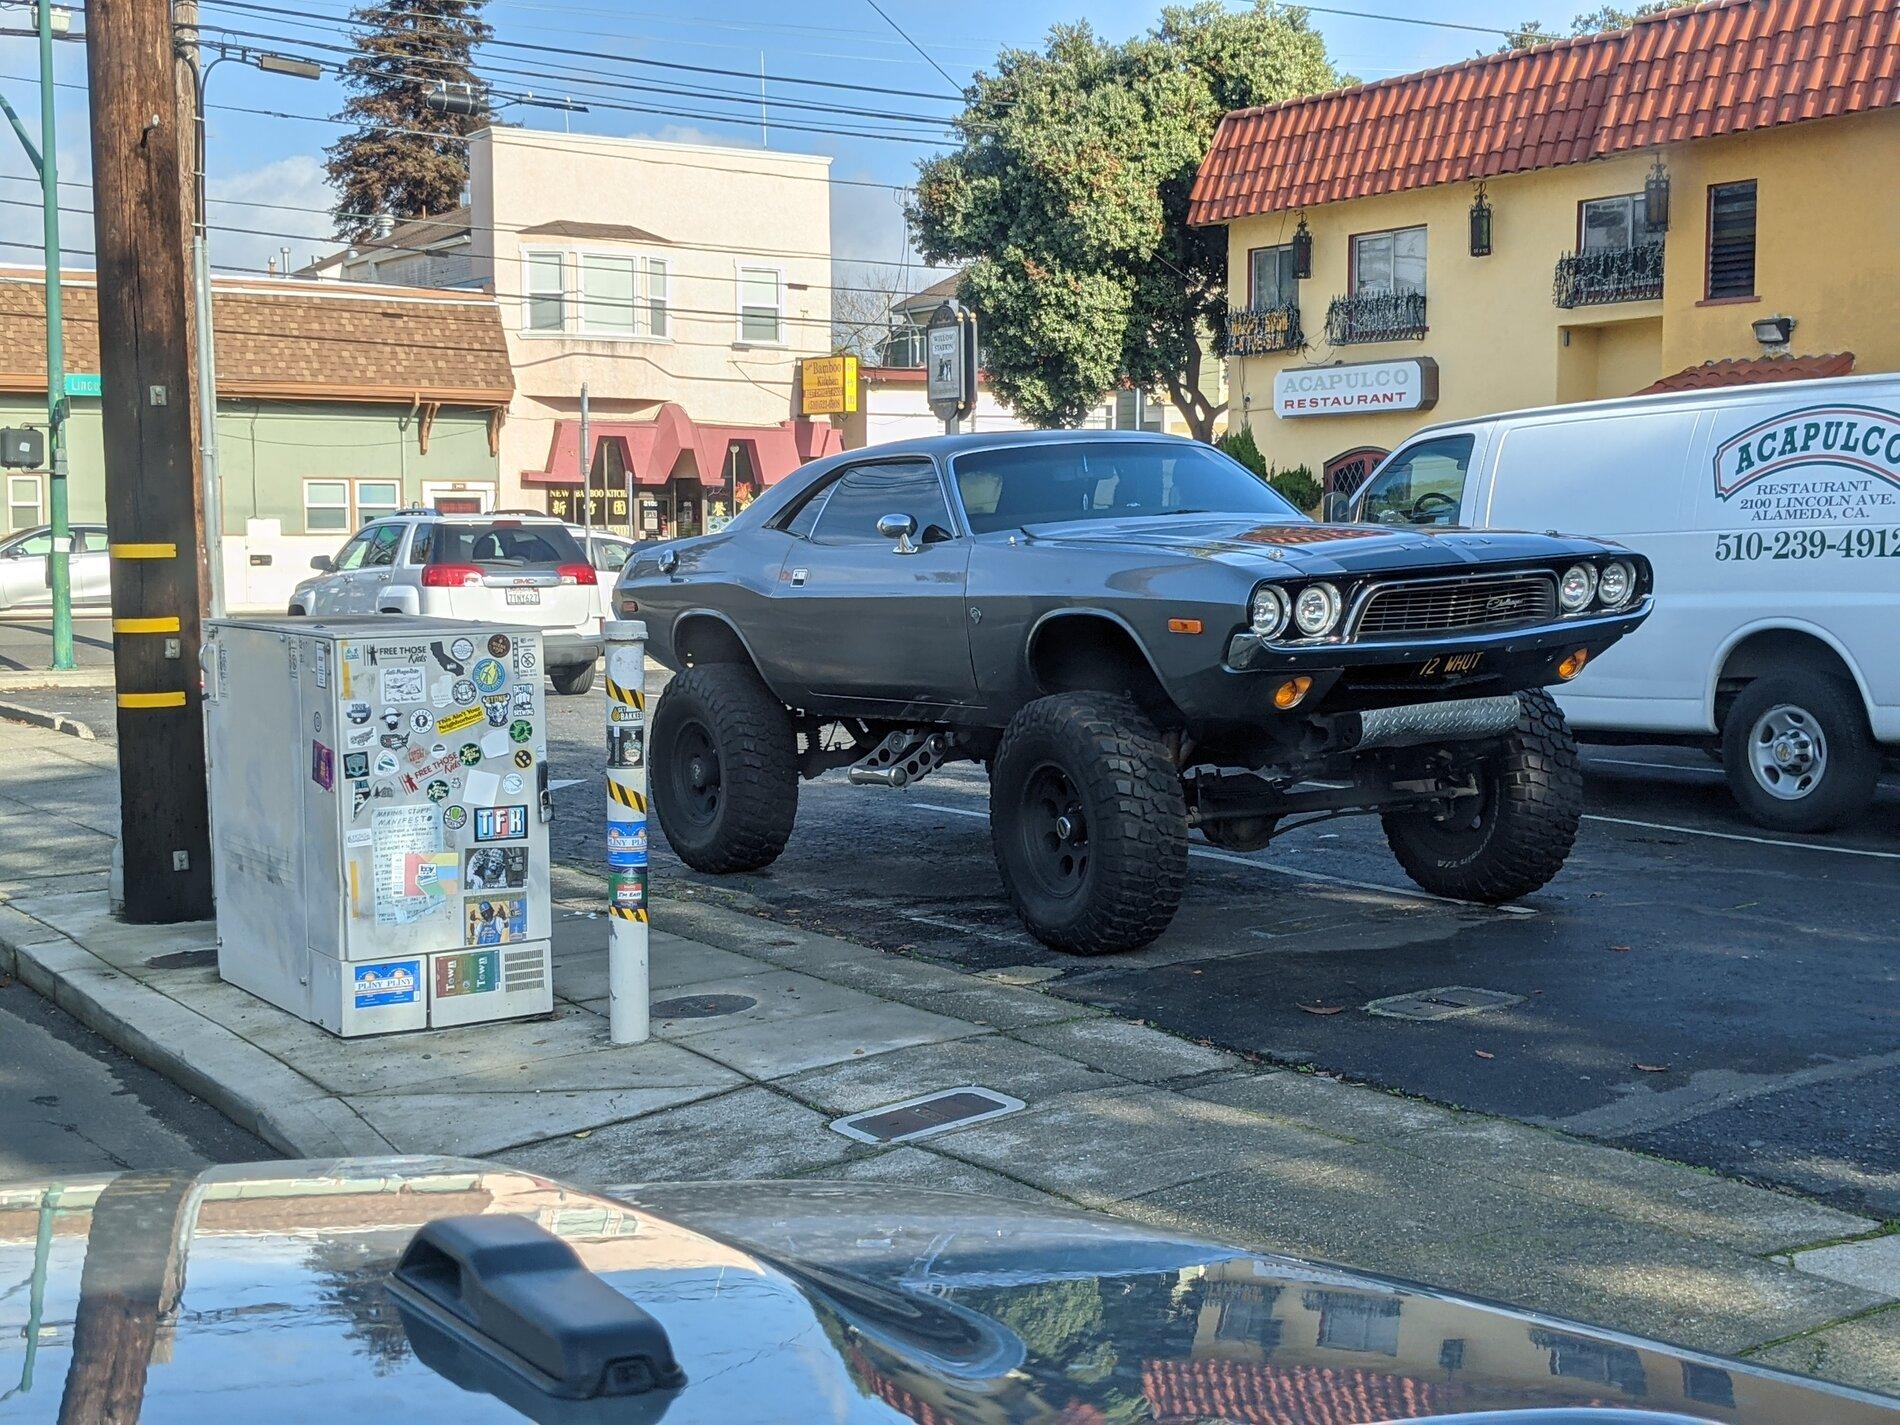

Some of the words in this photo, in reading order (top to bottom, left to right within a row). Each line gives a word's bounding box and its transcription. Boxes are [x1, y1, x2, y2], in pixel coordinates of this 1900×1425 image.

[813, 360, 842, 374] Bamboo
[70, 376, 101, 392] Linco
[1283, 368, 1409, 393] ACAPULCO
[1284, 391, 1407, 410] RESTAURANT
[549, 489, 570, 498] NEW
[575, 489, 604, 498] BABOO
[1756, 480, 1872, 496] RESTAURANT
[1740, 498, 1772, 510] 2100
[1775, 495, 1850, 509] LINCOLN
[1856, 493, 1896, 506] AVE.
[1751, 508, 1837, 521] ALAMEDA,
[1842, 507, 1870, 519] CA.
[1715, 528, 1900, 561] 510-239-4912
[379, 647, 398, 656] FREE
[399, 645, 427, 655] THOSE
[415, 765, 433, 779] FREE
[433, 751, 459, 769] THOSE
